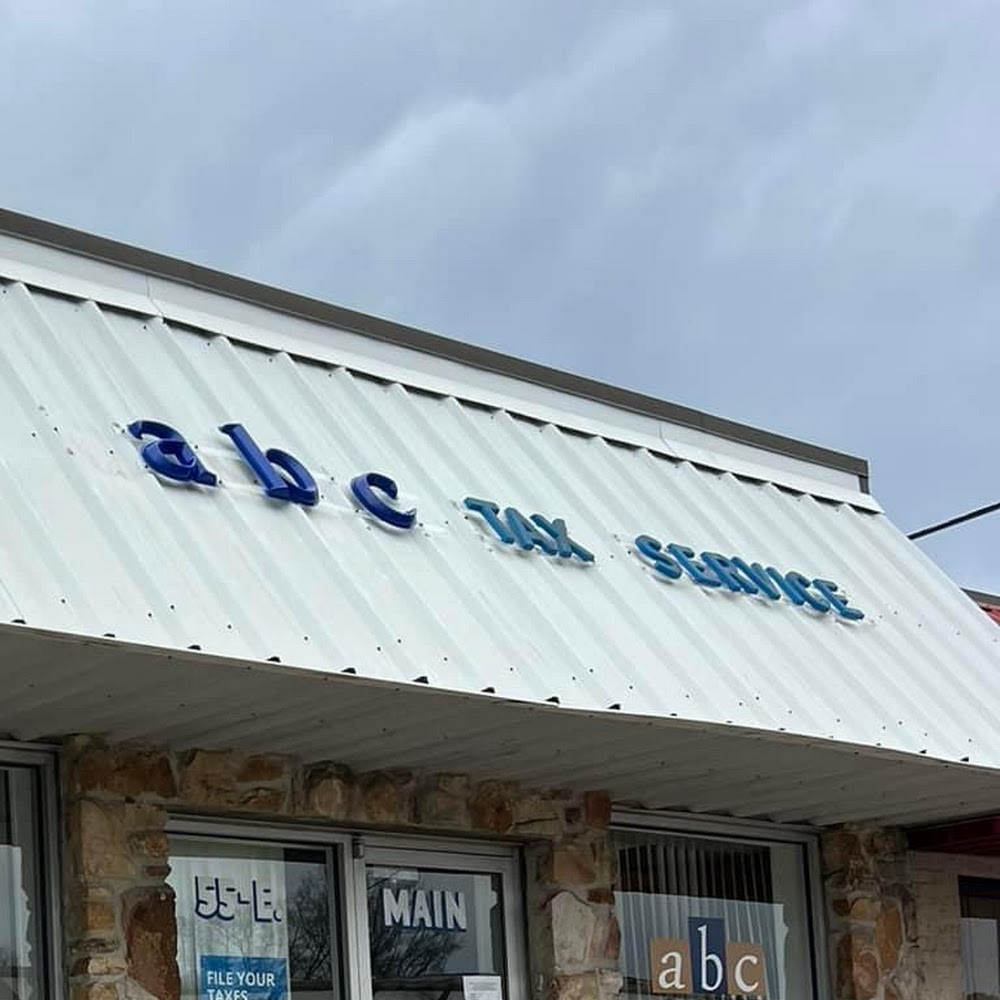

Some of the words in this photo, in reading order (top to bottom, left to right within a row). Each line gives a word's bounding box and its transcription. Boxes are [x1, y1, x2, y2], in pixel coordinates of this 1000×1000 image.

[464, 496, 596, 563] TAX
[634, 534, 866, 622] SERVICE
[382, 888, 468, 932] MAIN
[207, 970, 235, 986] FILE
[237, 971, 276, 988] YOUR
[657, 924, 760, 993] abc
